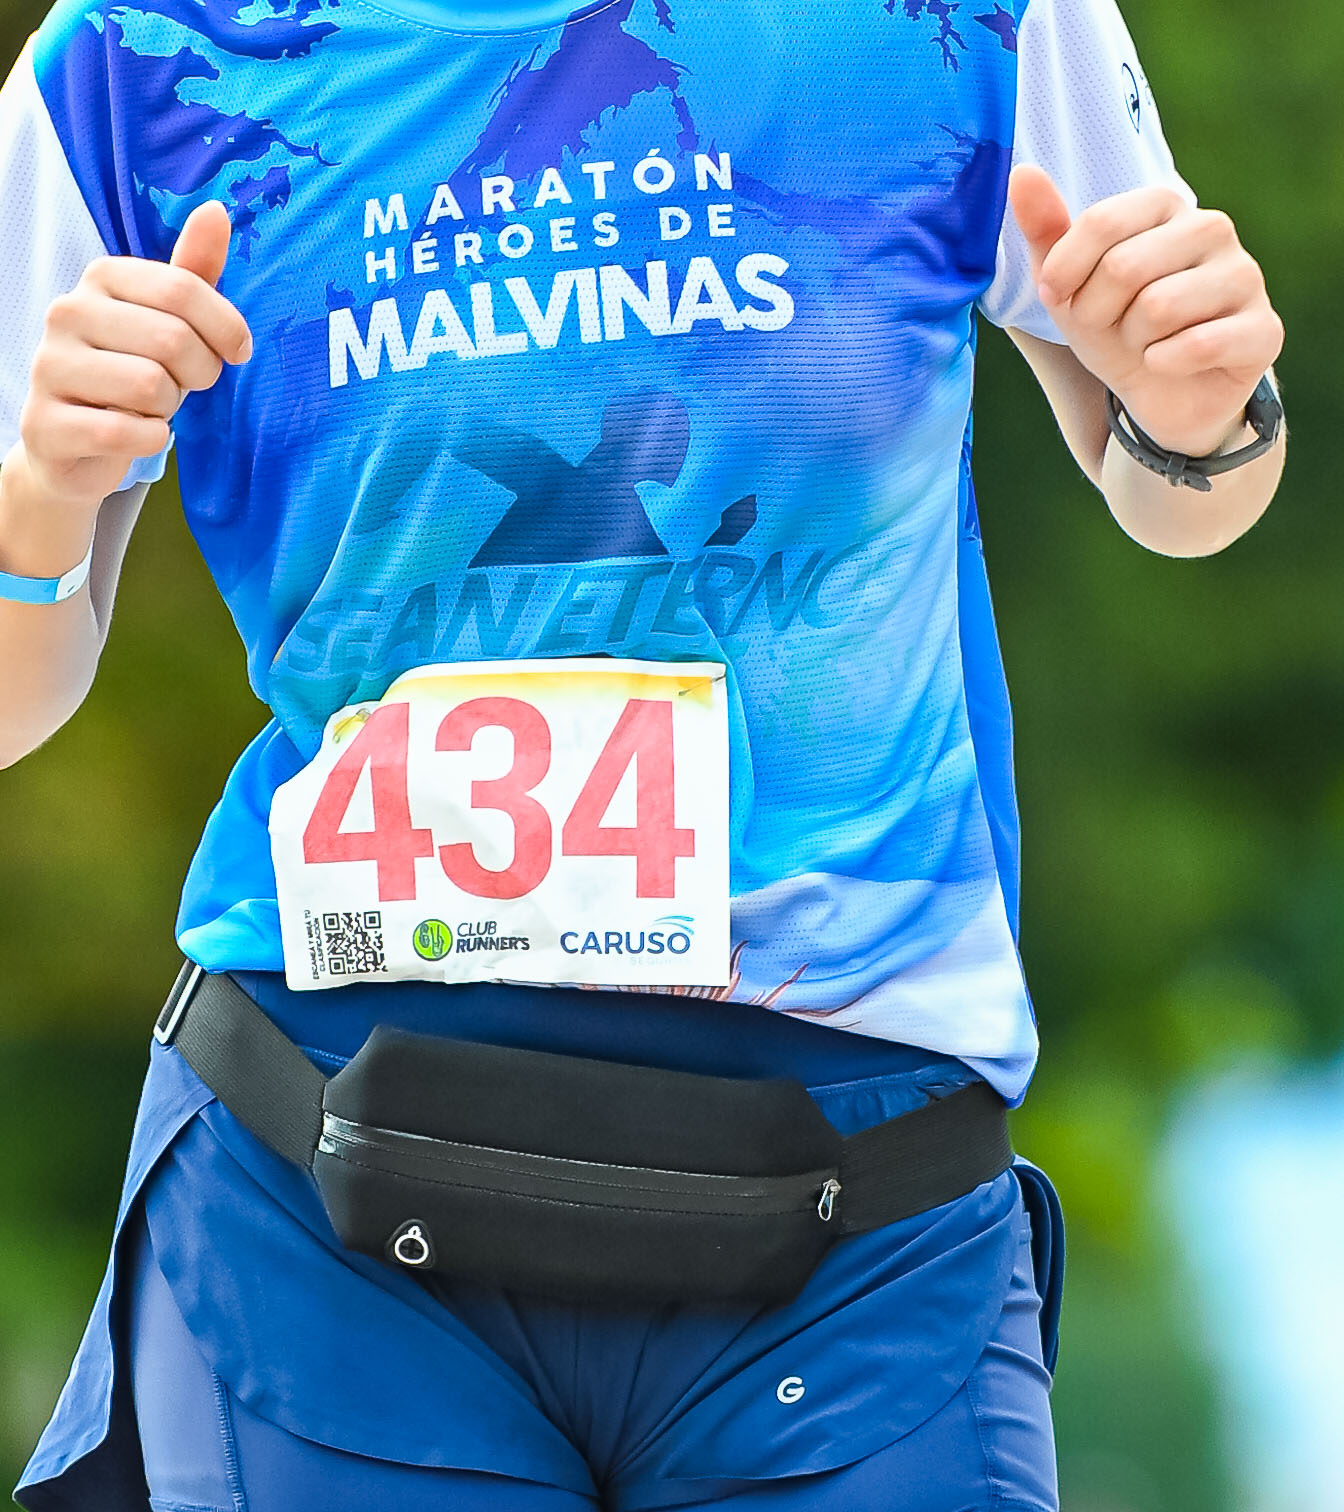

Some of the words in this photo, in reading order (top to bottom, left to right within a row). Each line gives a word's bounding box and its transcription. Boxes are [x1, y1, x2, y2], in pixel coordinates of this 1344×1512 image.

[363, 148, 734, 239] MARATÓN
[365, 211, 620, 284] HÉROES
[659, 203, 736, 241] DE
[327, 252, 795, 389] MALVINAS
[303, 695, 696, 902] 434
[457, 920, 498, 937] CLUB
[559, 931, 691, 955] CARUSO
[776, 1376, 806, 1404] G
